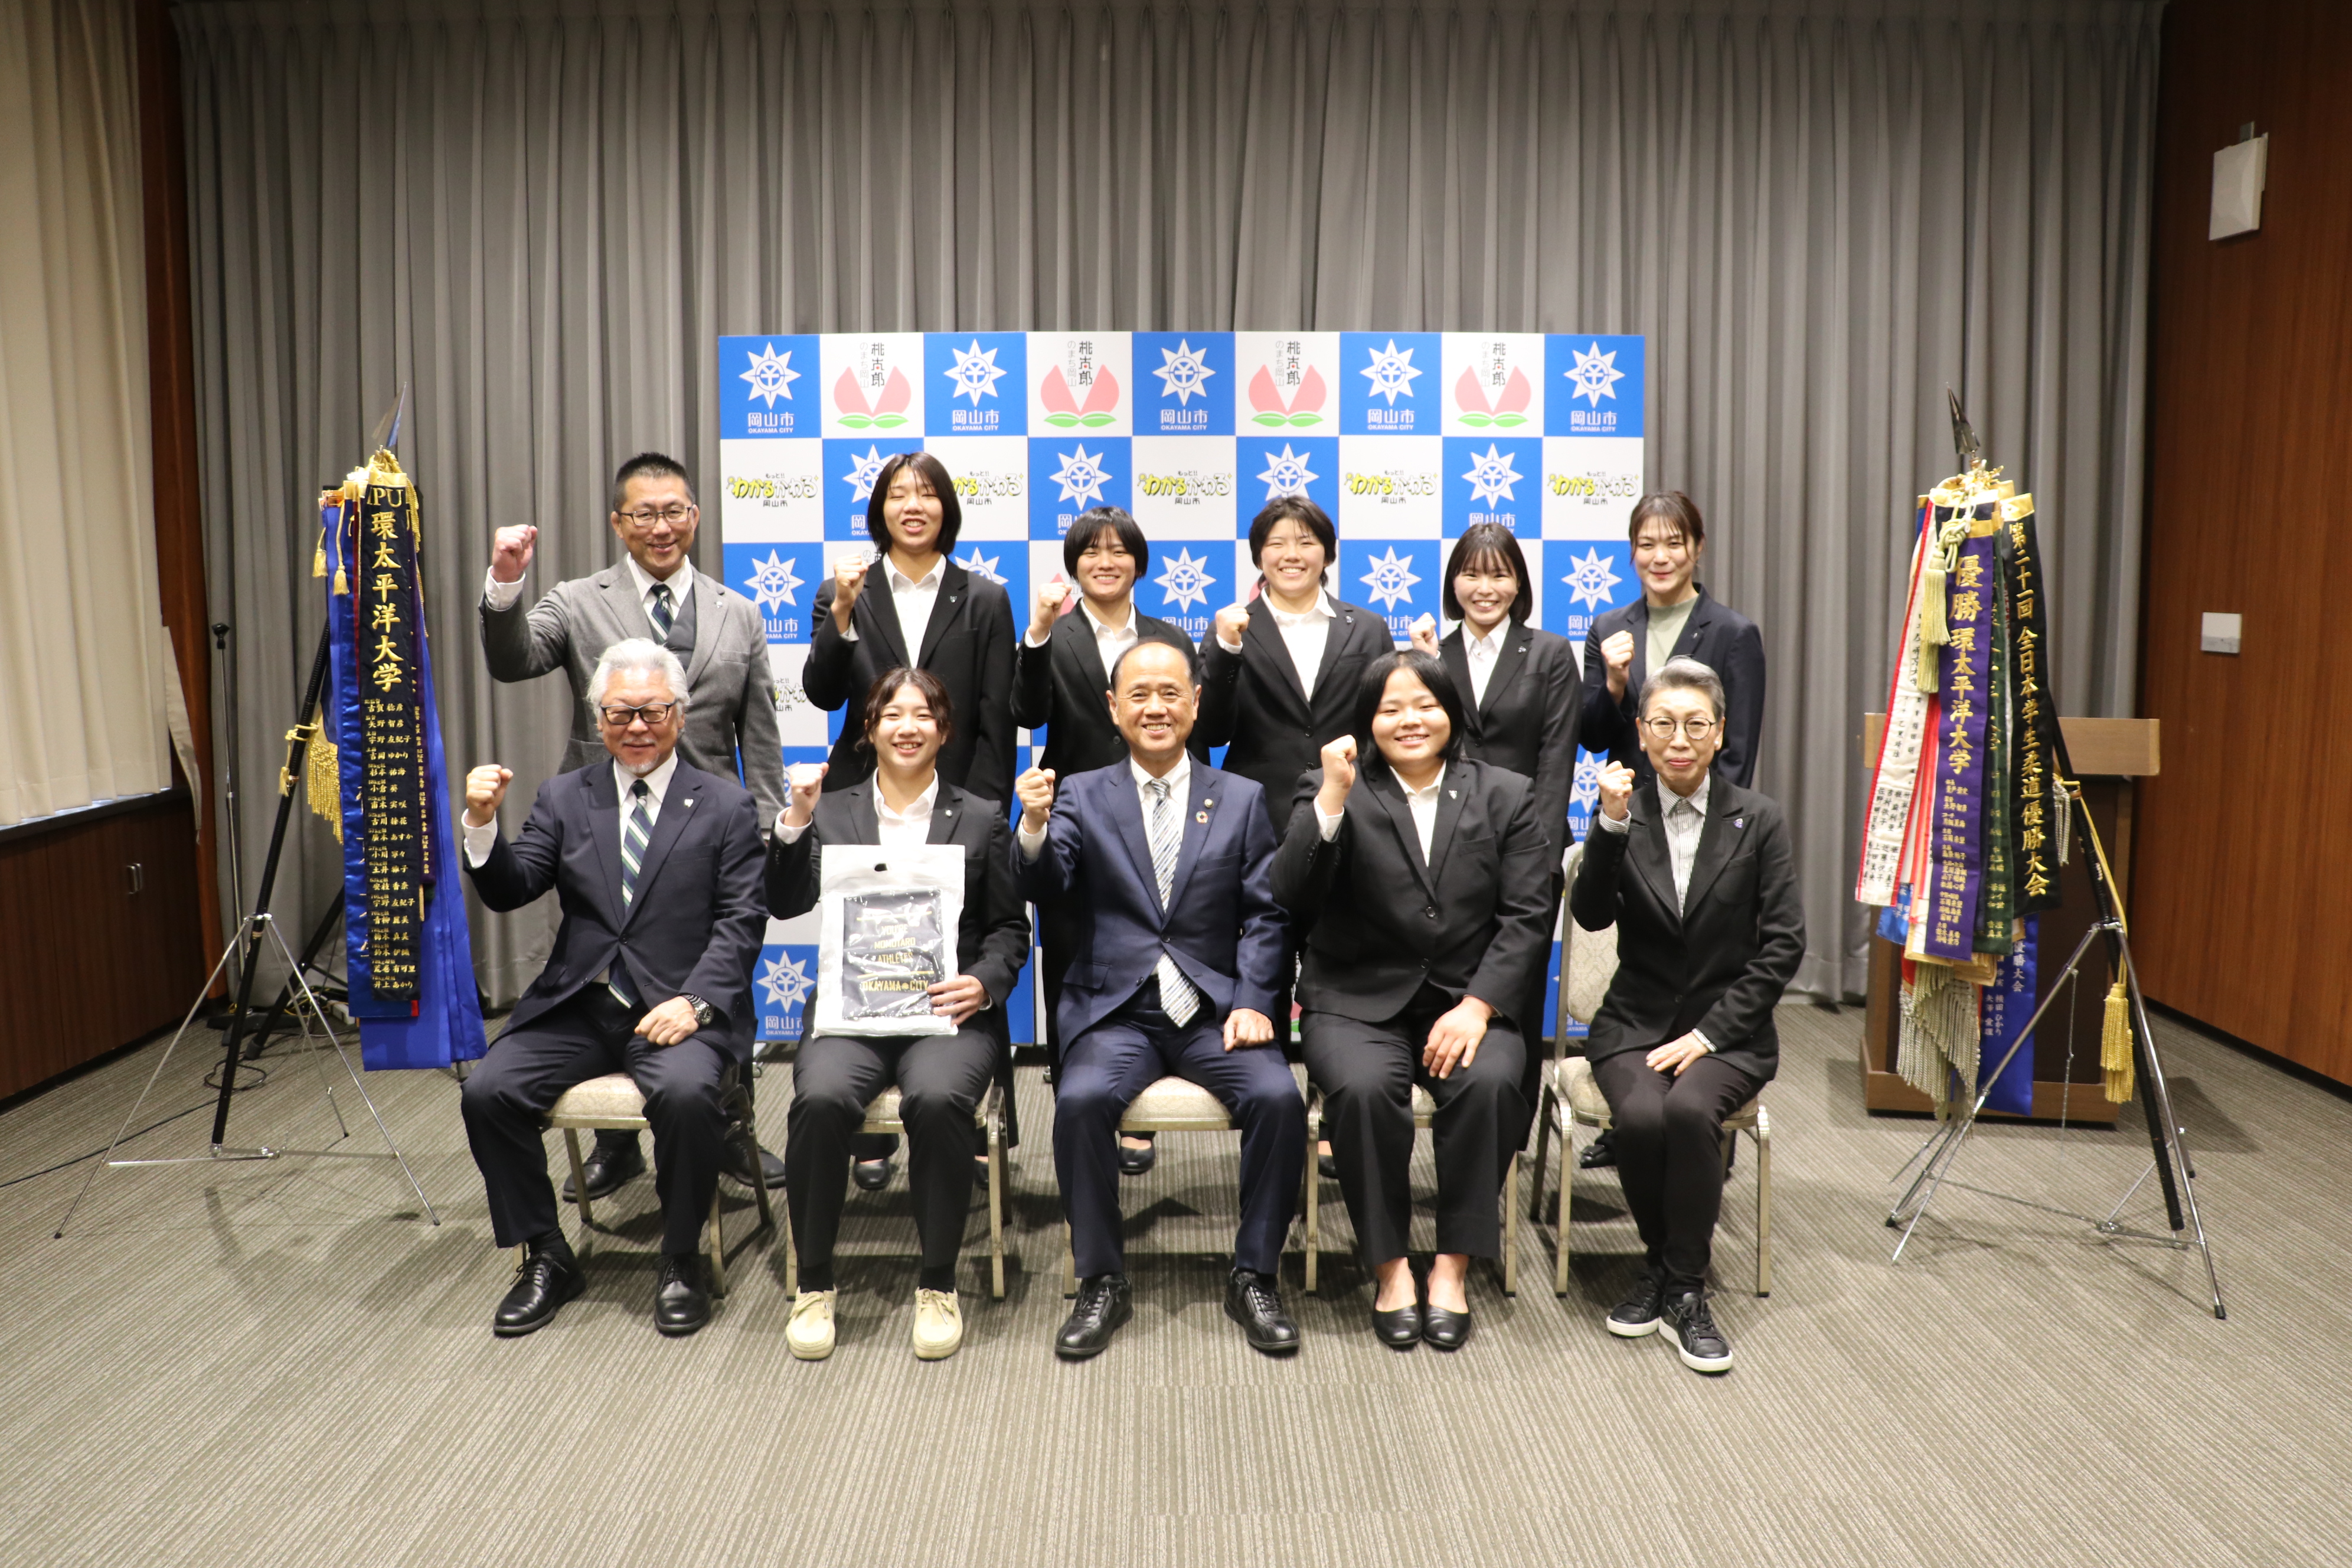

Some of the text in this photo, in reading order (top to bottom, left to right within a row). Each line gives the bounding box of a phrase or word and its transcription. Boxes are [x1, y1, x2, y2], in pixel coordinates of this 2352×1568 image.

[860, 342, 869, 388] のまち岡山
[871, 342, 885, 387] 桃太郎
[1067, 341, 1077, 387] のまち岡山
[1079, 341, 1092, 386] 桃太郎
[1275, 340, 1285, 387] のまち岡山
[1287, 341, 1301, 386] 桃太郎
[1481, 341, 1490, 387] のまち岡山
[1492, 342, 1506, 387] 桃太郎
[748, 411, 795, 427] 岡山市
[952, 410, 999, 424] 岡山市
[1161, 409, 1208, 424] 岡山市
[1368, 409, 1415, 423] 岡山市
[1570, 410, 1616, 426] 岡山市
[731, 475, 818, 498] わかるかわる
[952, 473, 1023, 496] かるかわる
[1142, 472, 1231, 495] わかるかわる
[1348, 472, 1437, 495] わかるかわる
[1553, 474, 1638, 496] わかるかわる
[367, 487, 404, 508] IPU
[1949, 554, 1984, 622] 優勝
[371, 510, 404, 692] 環太平洋大学
[762, 618, 798, 632] 山市
[1384, 615, 1413, 629] 山市
[1568, 615, 1593, 630] 岡山
[1948, 627, 1977, 774] 環太平洋大学
[2009, 522, 2050, 897] 第二十一回 全日本学生柔道優勝大会
[368, 719, 386, 728] 矢野
[874, 937, 916, 949] MOMOTARO
[878, 952, 913, 964] ATHLETES
[862, 980, 929, 991] OKAYAMA CITY
